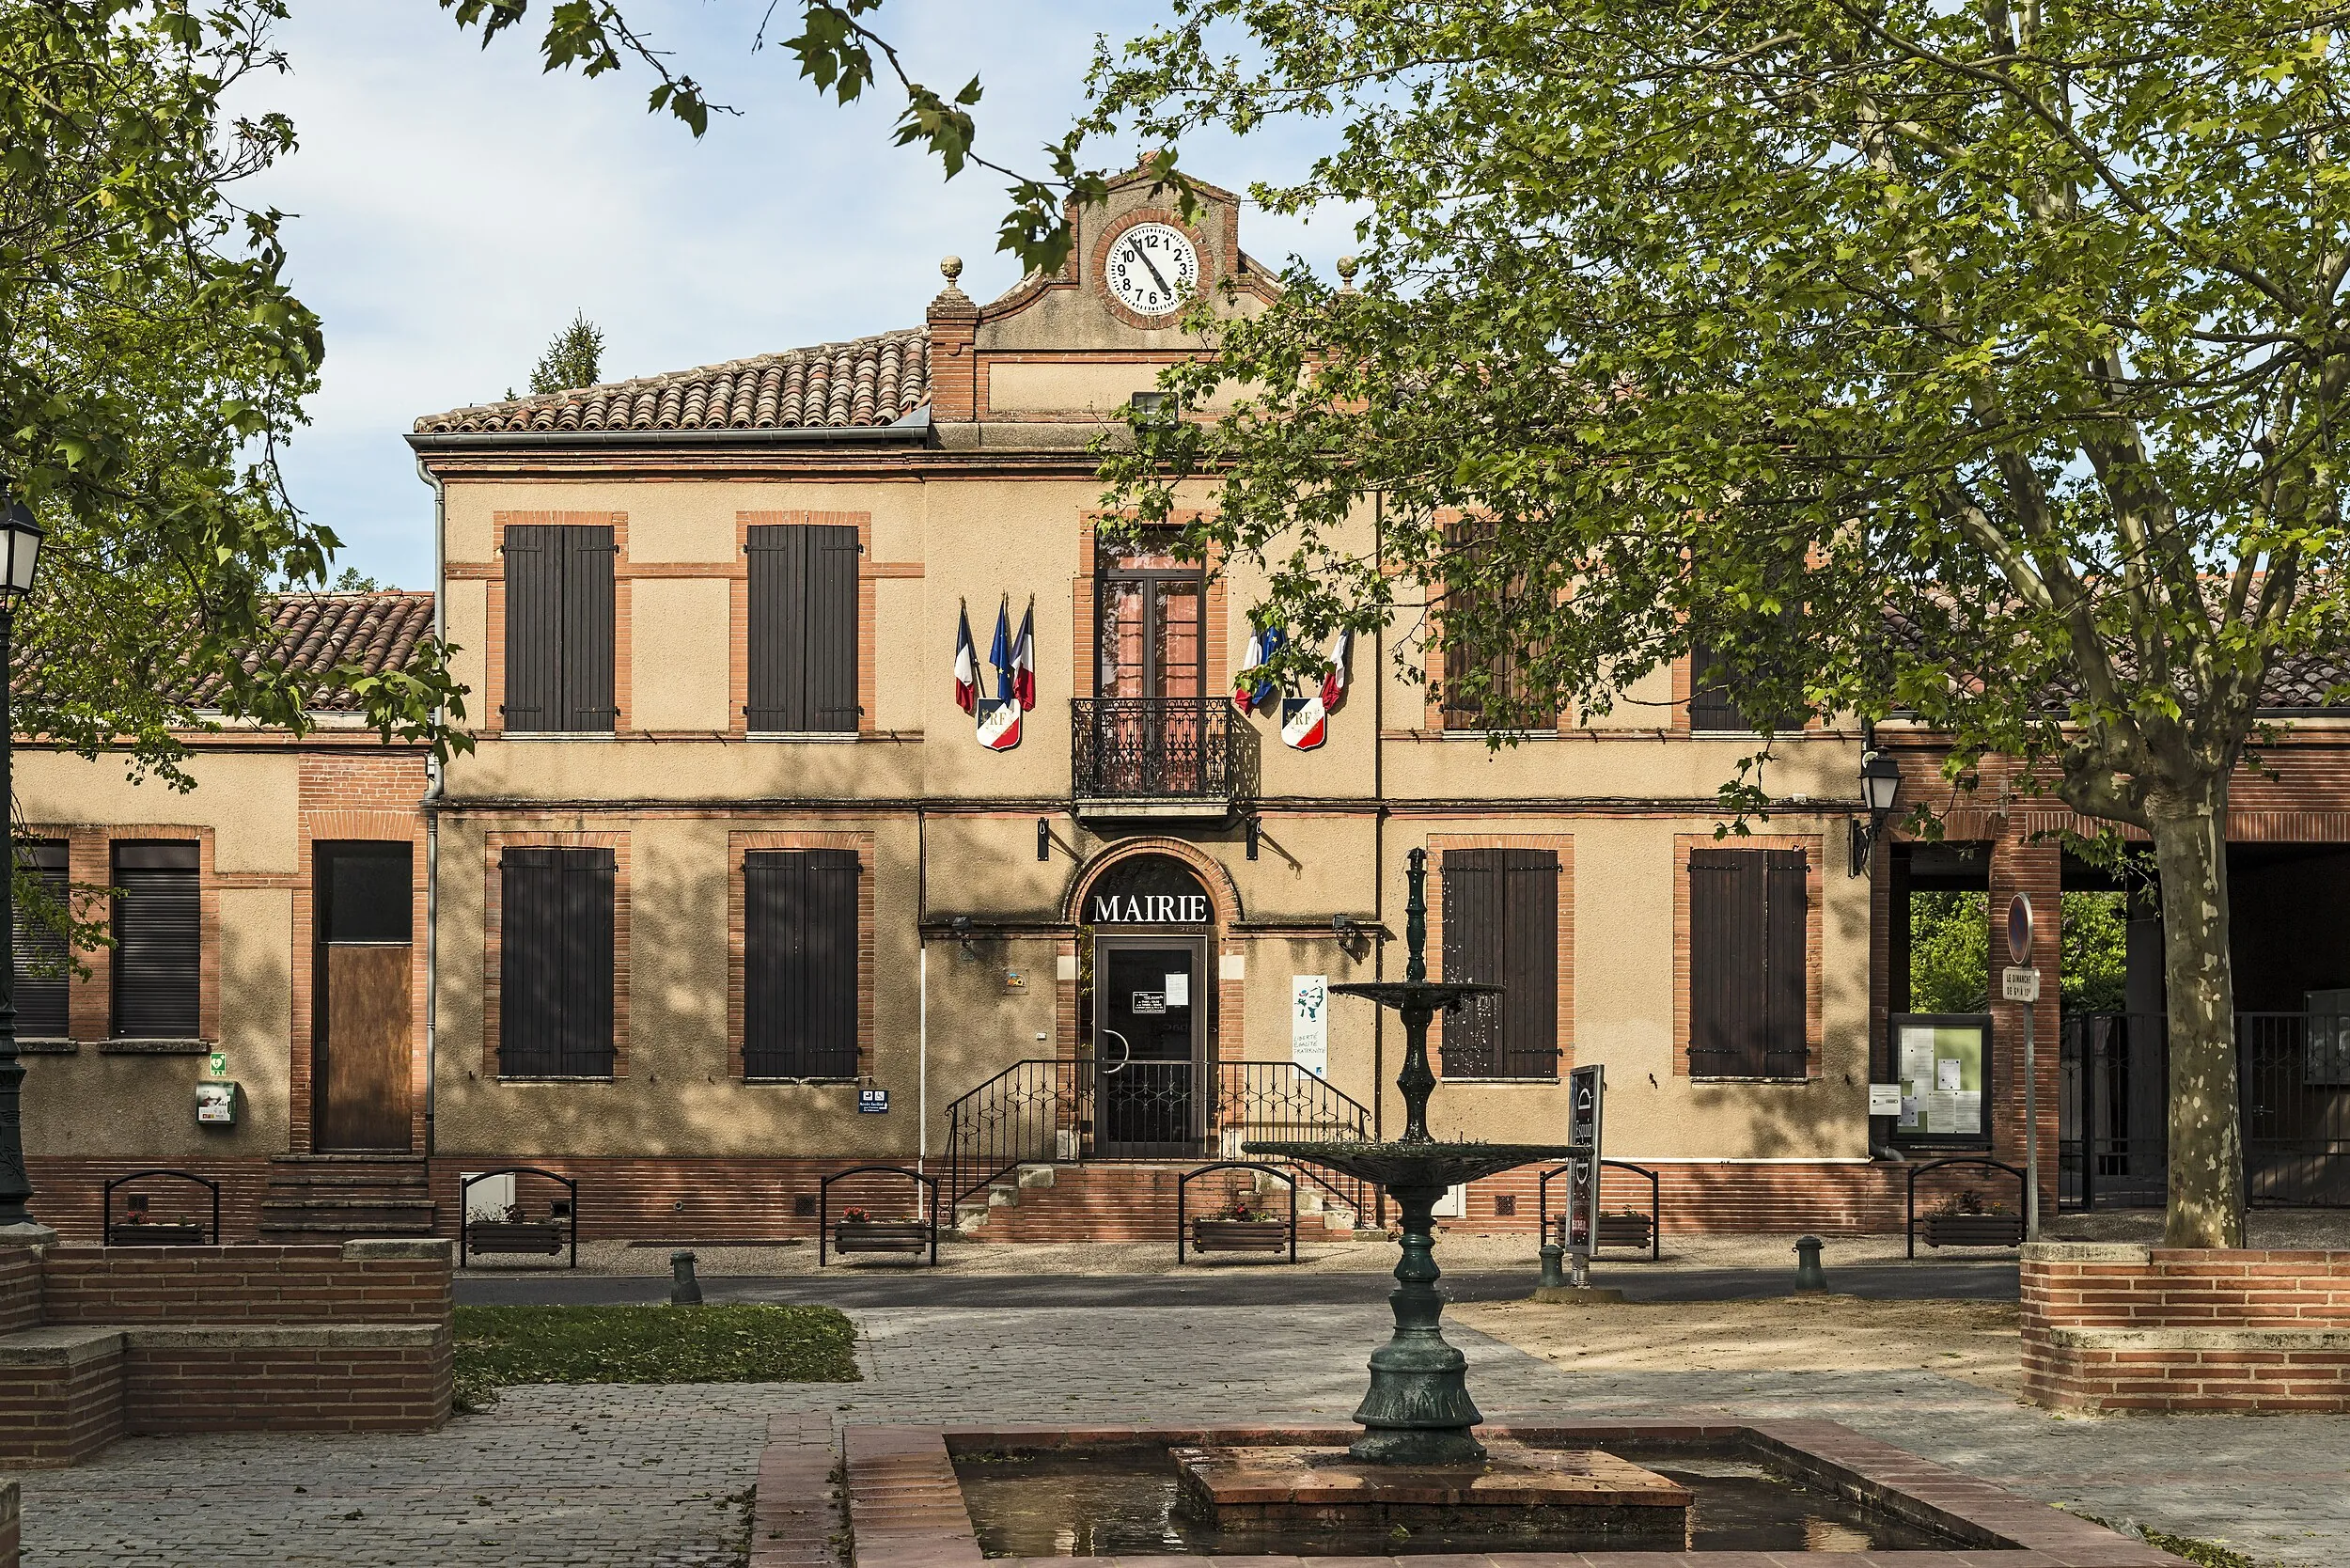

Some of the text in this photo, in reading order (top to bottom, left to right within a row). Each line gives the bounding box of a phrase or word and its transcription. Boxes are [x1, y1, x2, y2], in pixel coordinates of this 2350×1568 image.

[1134, 239, 1143, 251] 1
[1144, 235, 1158, 248] 12
[1164, 238, 1169, 251] 1
[1121, 249, 1135, 263] 10
[1173, 248, 1183, 261] 2
[1117, 264, 1126, 276] 9
[1179, 263, 1187, 275] 3
[1122, 278, 1131, 290] 8
[1135, 289, 1144, 301] 7
[1149, 291, 1157, 305] 6
[1164, 288, 1171, 301] 5
[989, 712, 1007, 726] RF
[1294, 712, 1312, 726] RF
[1092, 894, 1207, 922] MAIRIE
[2006, 974, 2031, 984] LE DIMANCHE
[2007, 986, 2013, 996] DE
[1293, 1031, 1319, 1042] LIBERTÉ
